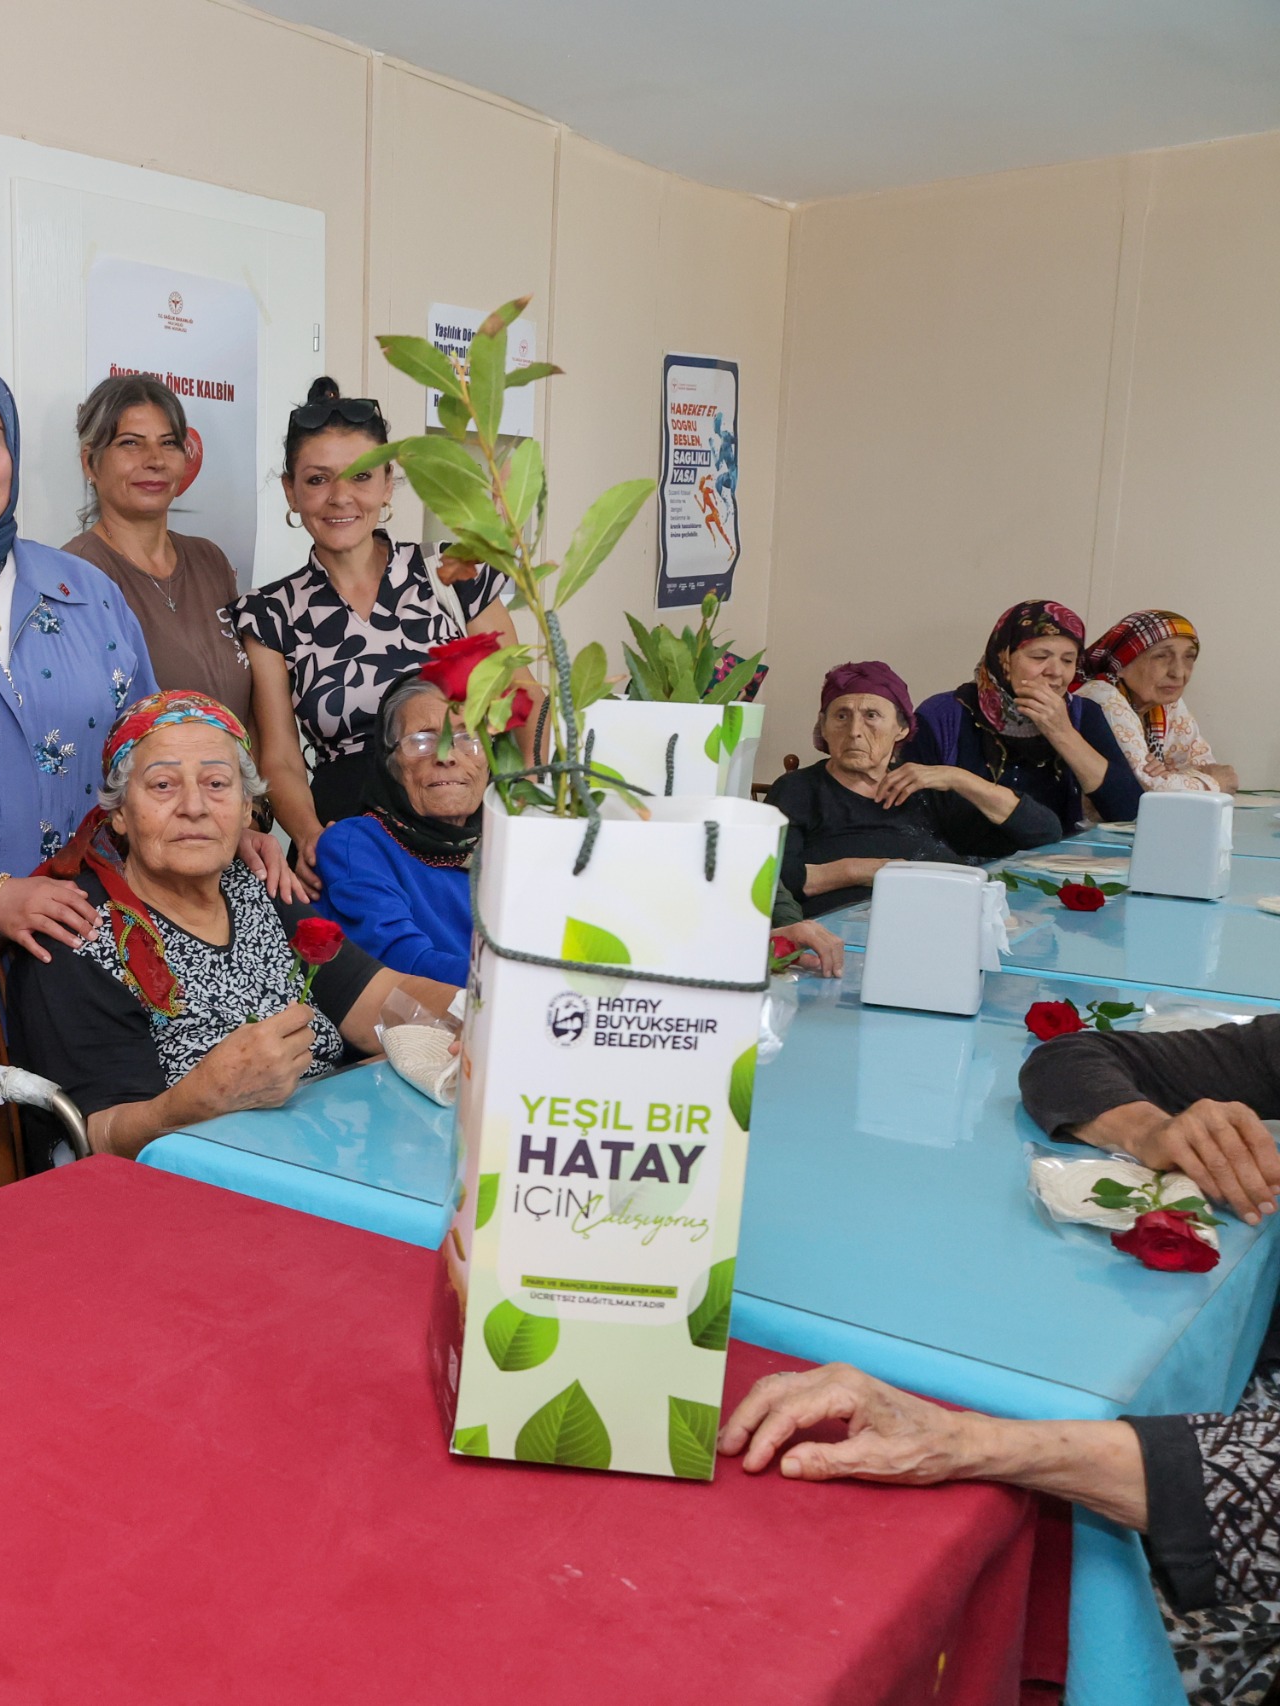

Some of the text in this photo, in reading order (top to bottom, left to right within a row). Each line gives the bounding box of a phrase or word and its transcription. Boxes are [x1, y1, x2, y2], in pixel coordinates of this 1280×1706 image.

[166, 371, 194, 397] ÖNCE
[196, 381, 235, 402] KALBİN
[670, 402, 707, 417] HAREKET
[597, 996, 663, 1014] HATAY
[520, 1094, 712, 1137] YEŞİL BİR
[518, 1134, 706, 1184] HATAY
[514, 1183, 592, 1222] İÇİN
[578, 1295, 665, 1309] DAĞITILMAKTADIR
